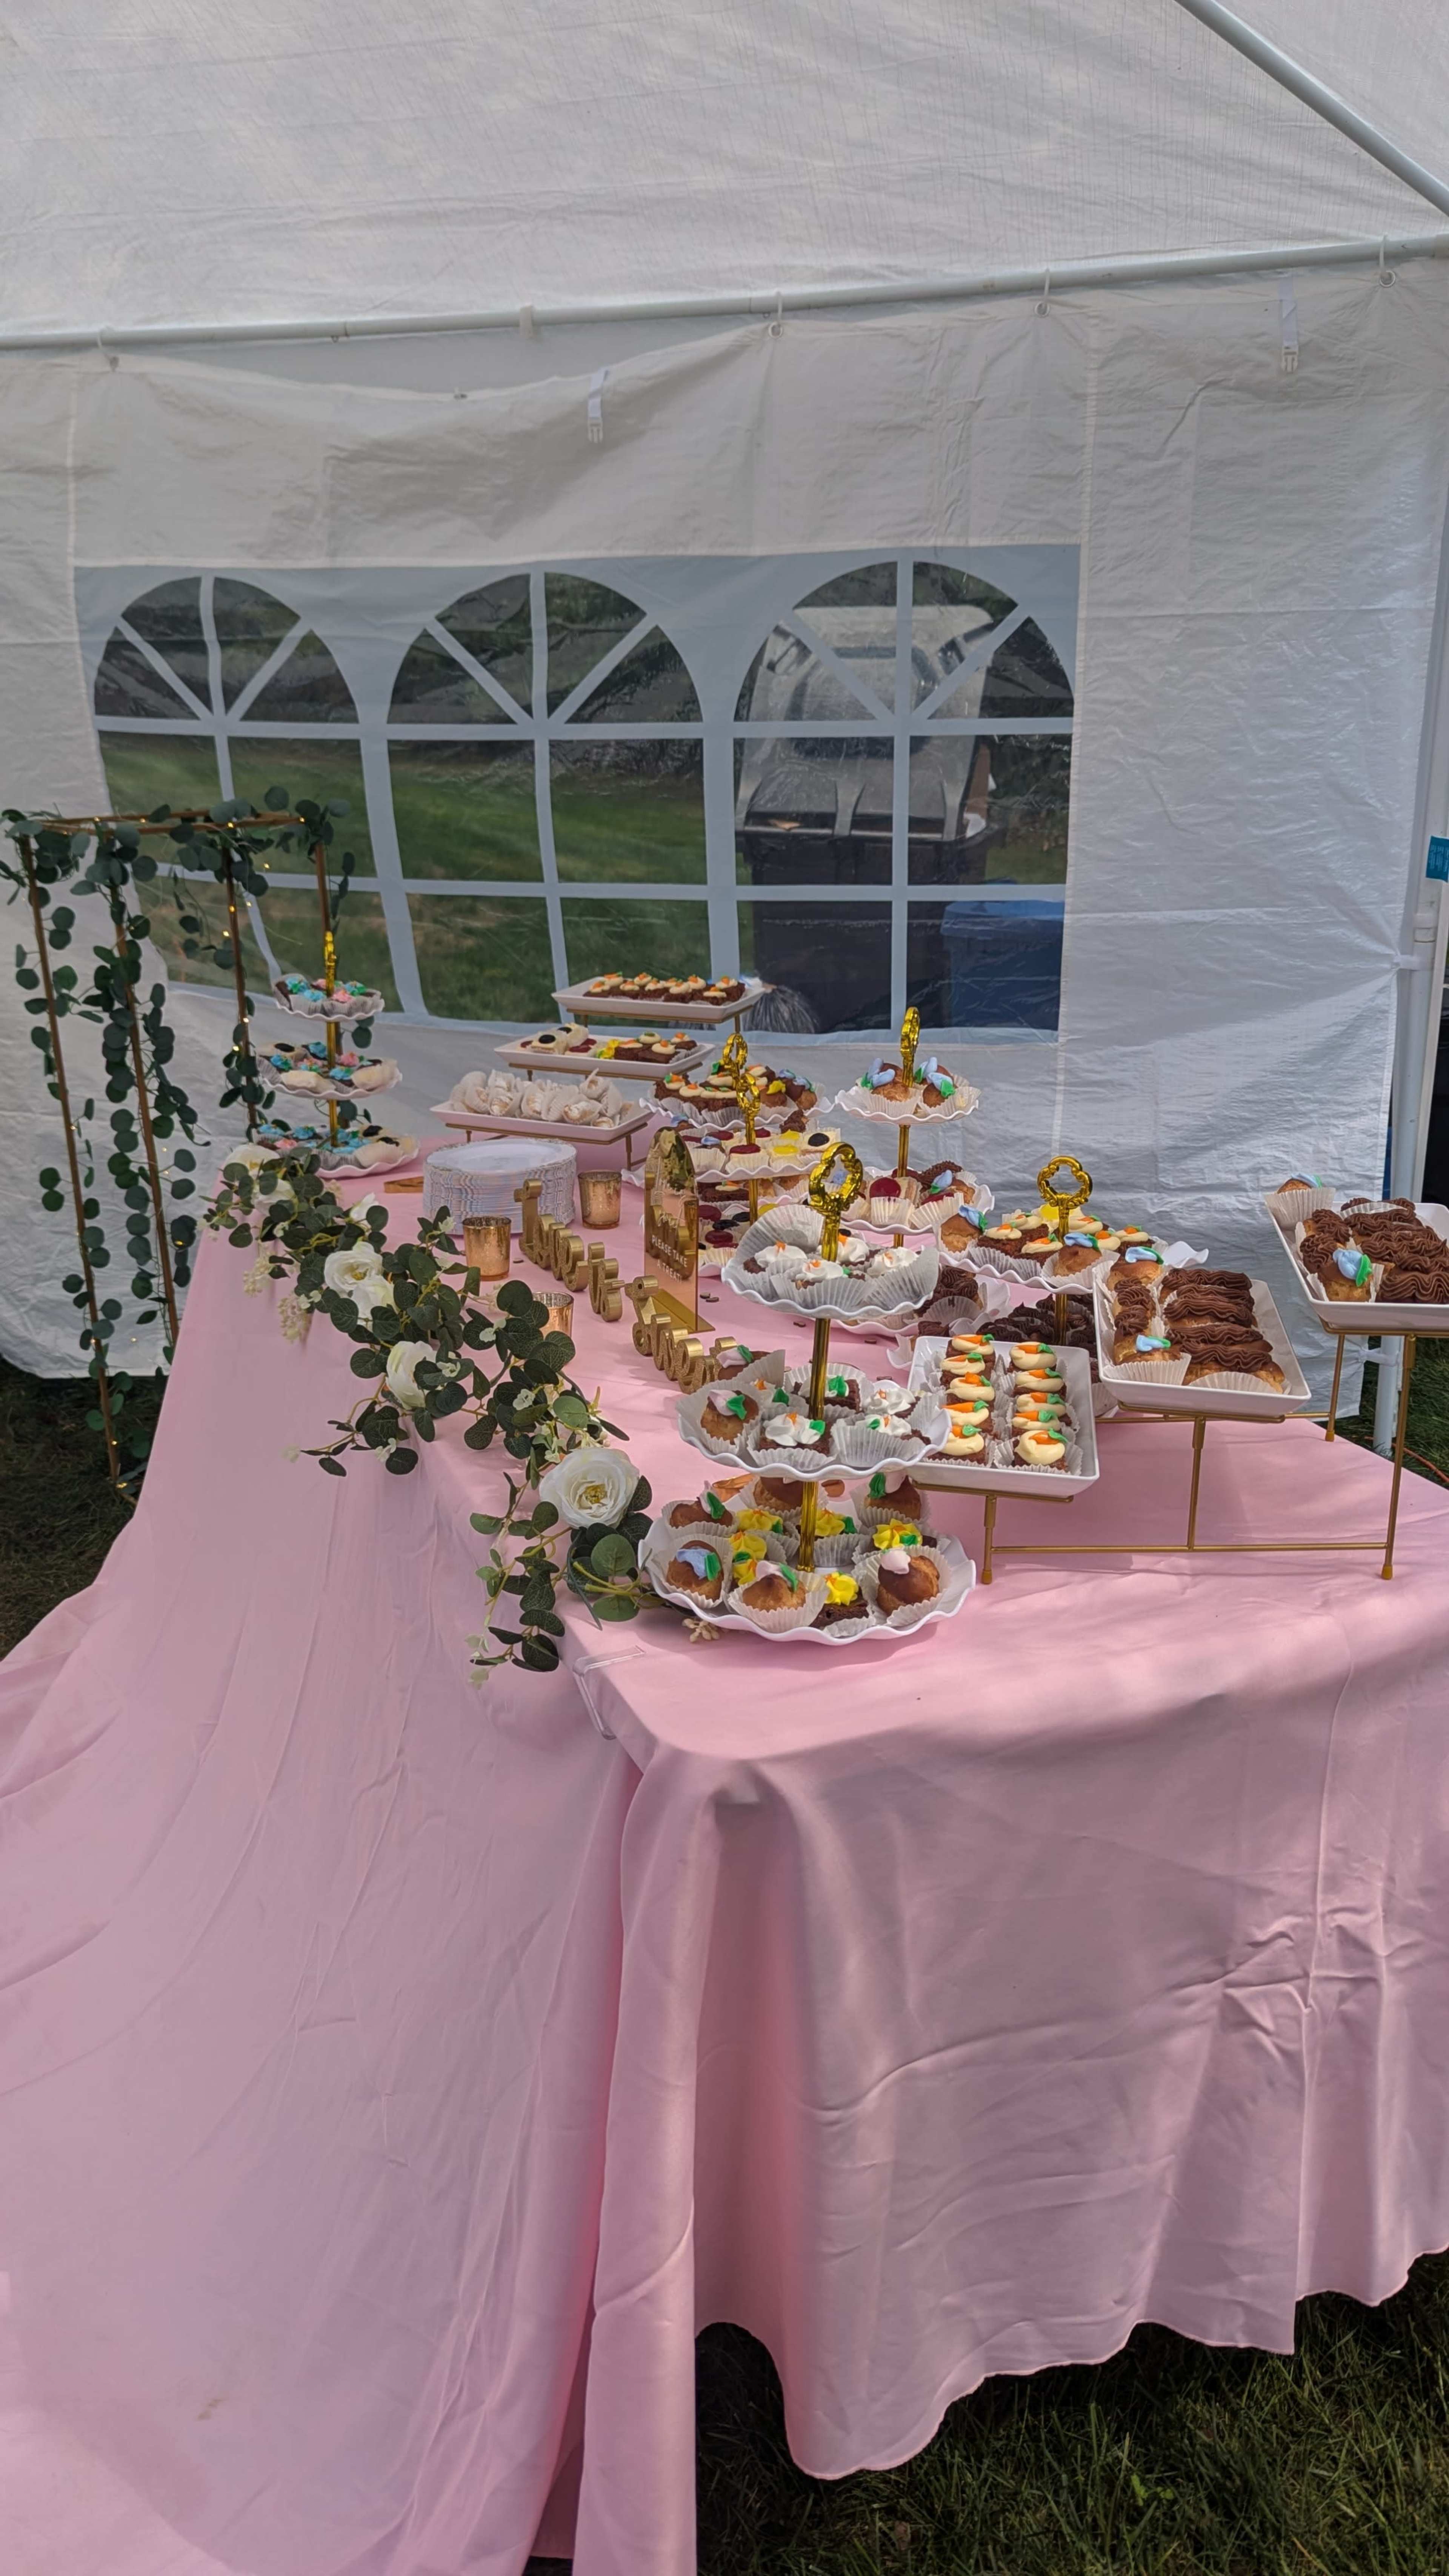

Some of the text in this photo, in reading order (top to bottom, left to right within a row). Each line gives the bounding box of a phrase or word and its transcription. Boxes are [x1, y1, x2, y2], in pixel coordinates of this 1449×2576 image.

[514, 1178, 588, 1292] Love
[588, 1242, 625, 1322] is
[652, 1235, 688, 1267] PLEASE TAKE
[657, 1260, 661, 1268] A
